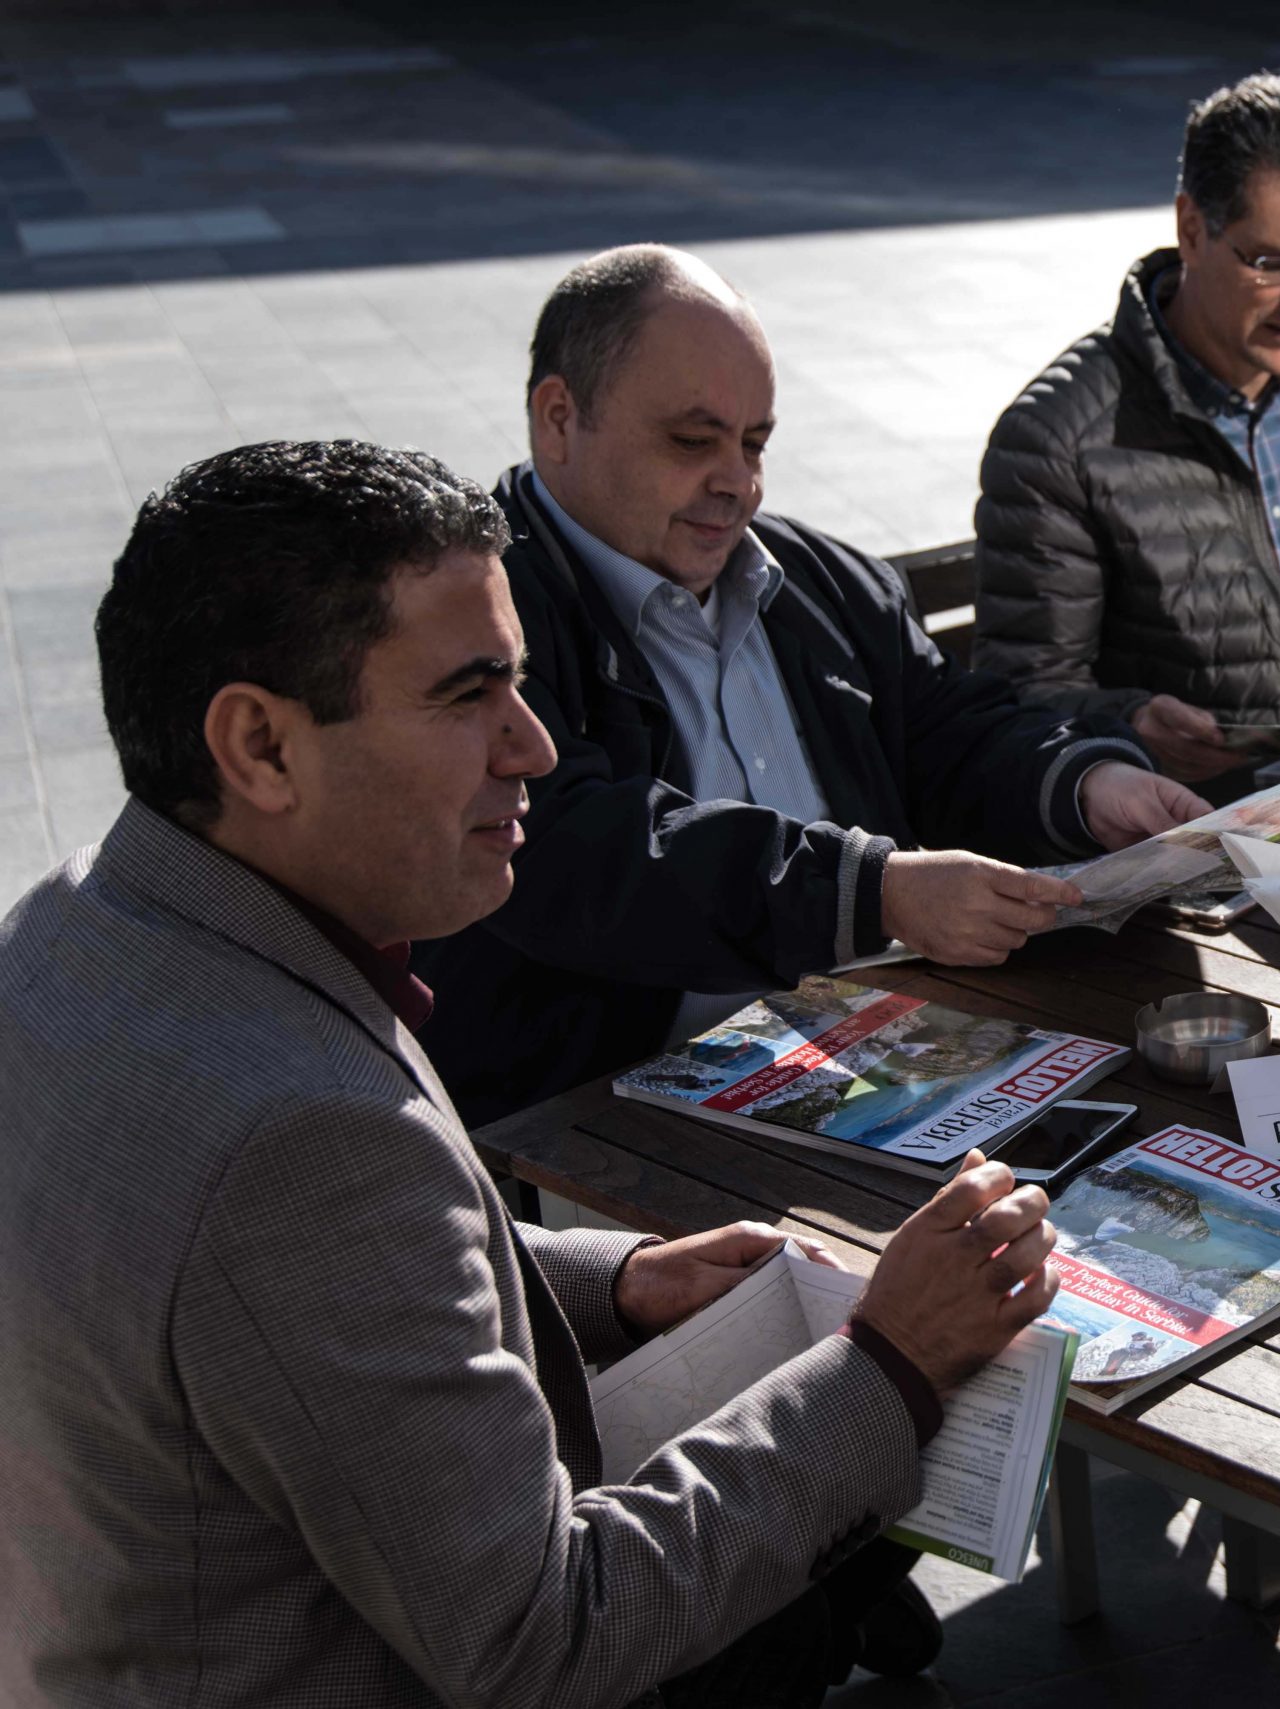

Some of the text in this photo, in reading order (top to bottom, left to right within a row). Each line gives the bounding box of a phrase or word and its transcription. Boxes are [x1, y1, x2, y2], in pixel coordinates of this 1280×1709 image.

[1001, 1040, 1112, 1101] HELLO!
[901, 1092, 1011, 1150] SERBIA
[986, 1101, 1031, 1128] travel
[1147, 1131, 1278, 1187] HELLO!
[1071, 1278, 1126, 1308] Holiday
[1123, 1303, 1141, 1315] in
[1139, 1309, 1194, 1335] Serbia!
[1072, 1269, 1124, 1293] Perfect
[948, 1547, 990, 1571] UNESCO
